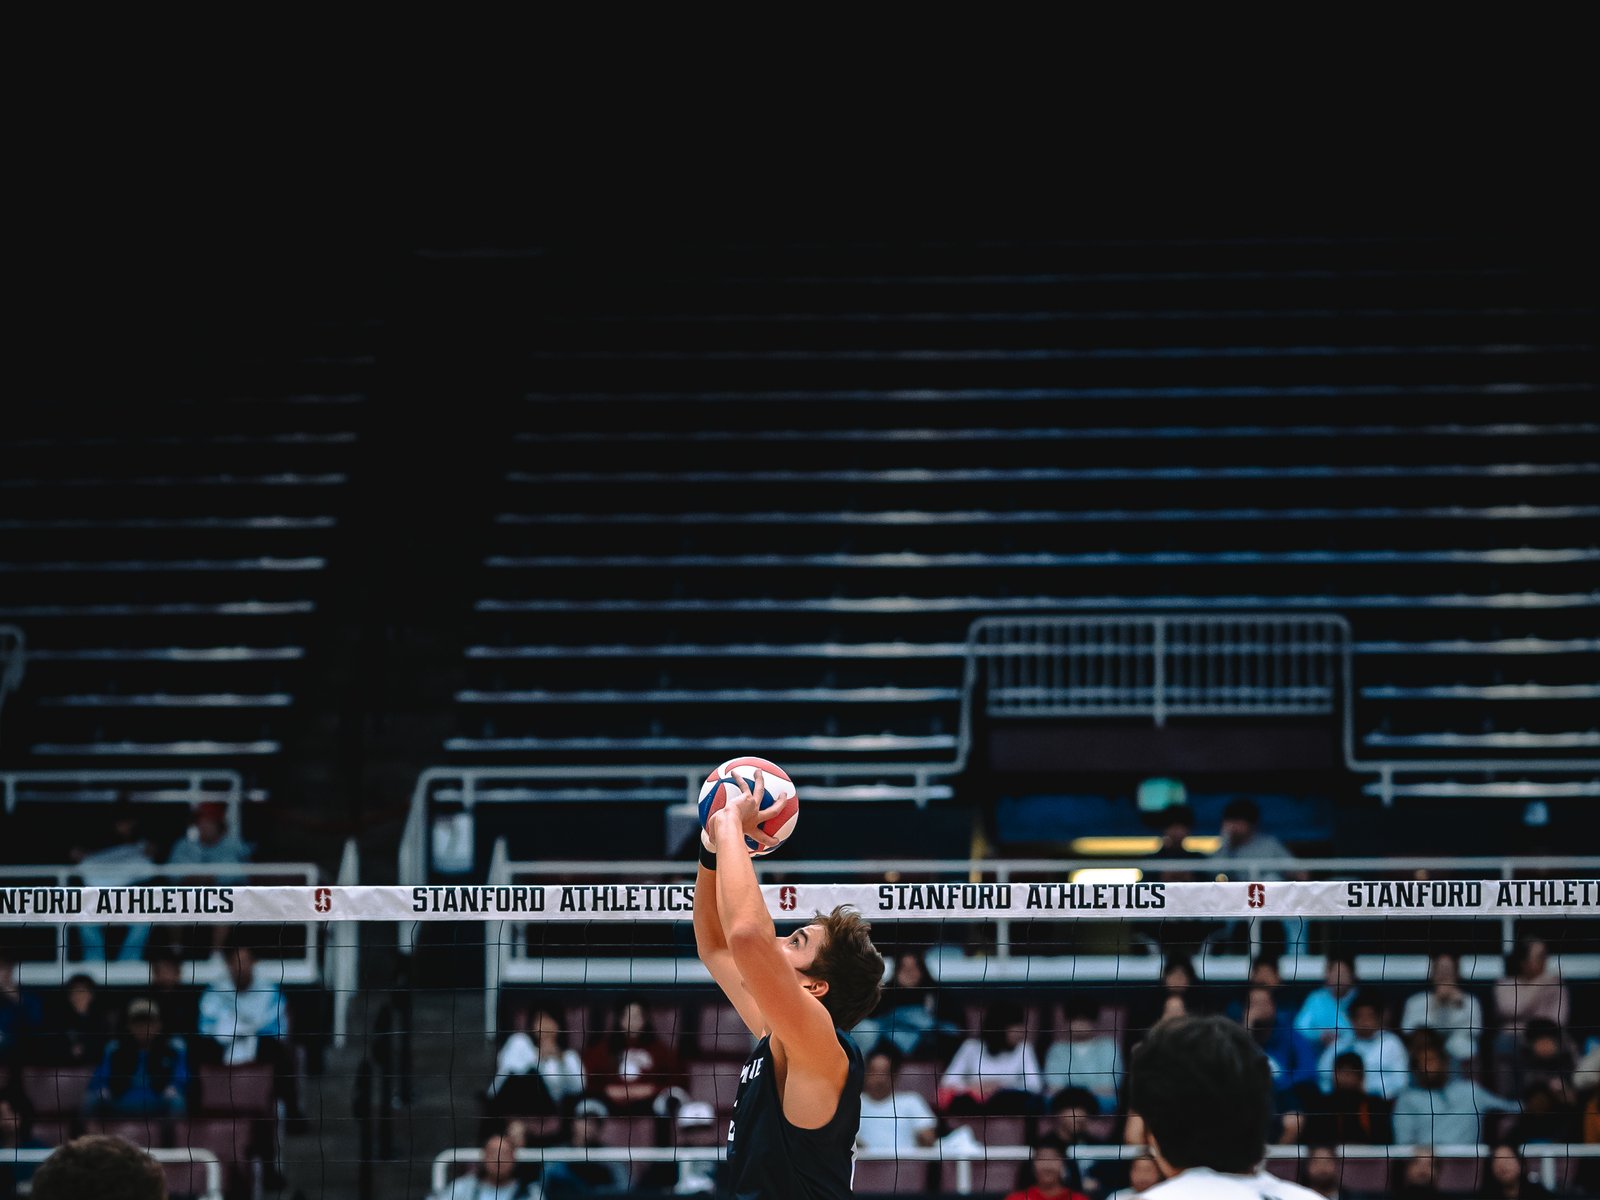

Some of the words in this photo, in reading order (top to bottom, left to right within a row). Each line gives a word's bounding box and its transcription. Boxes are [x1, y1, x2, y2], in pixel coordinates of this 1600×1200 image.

[0, 888, 82, 914] NFORD
[96, 888, 234, 914] ATHLETICS
[412, 887, 545, 912] STANFORD
[559, 886, 693, 912] ATHLETICS
[878, 885, 1012, 911] STANFORD
[1026, 884, 1166, 910] ATHLETICS
[1347, 882, 1482, 908] STANFORD
